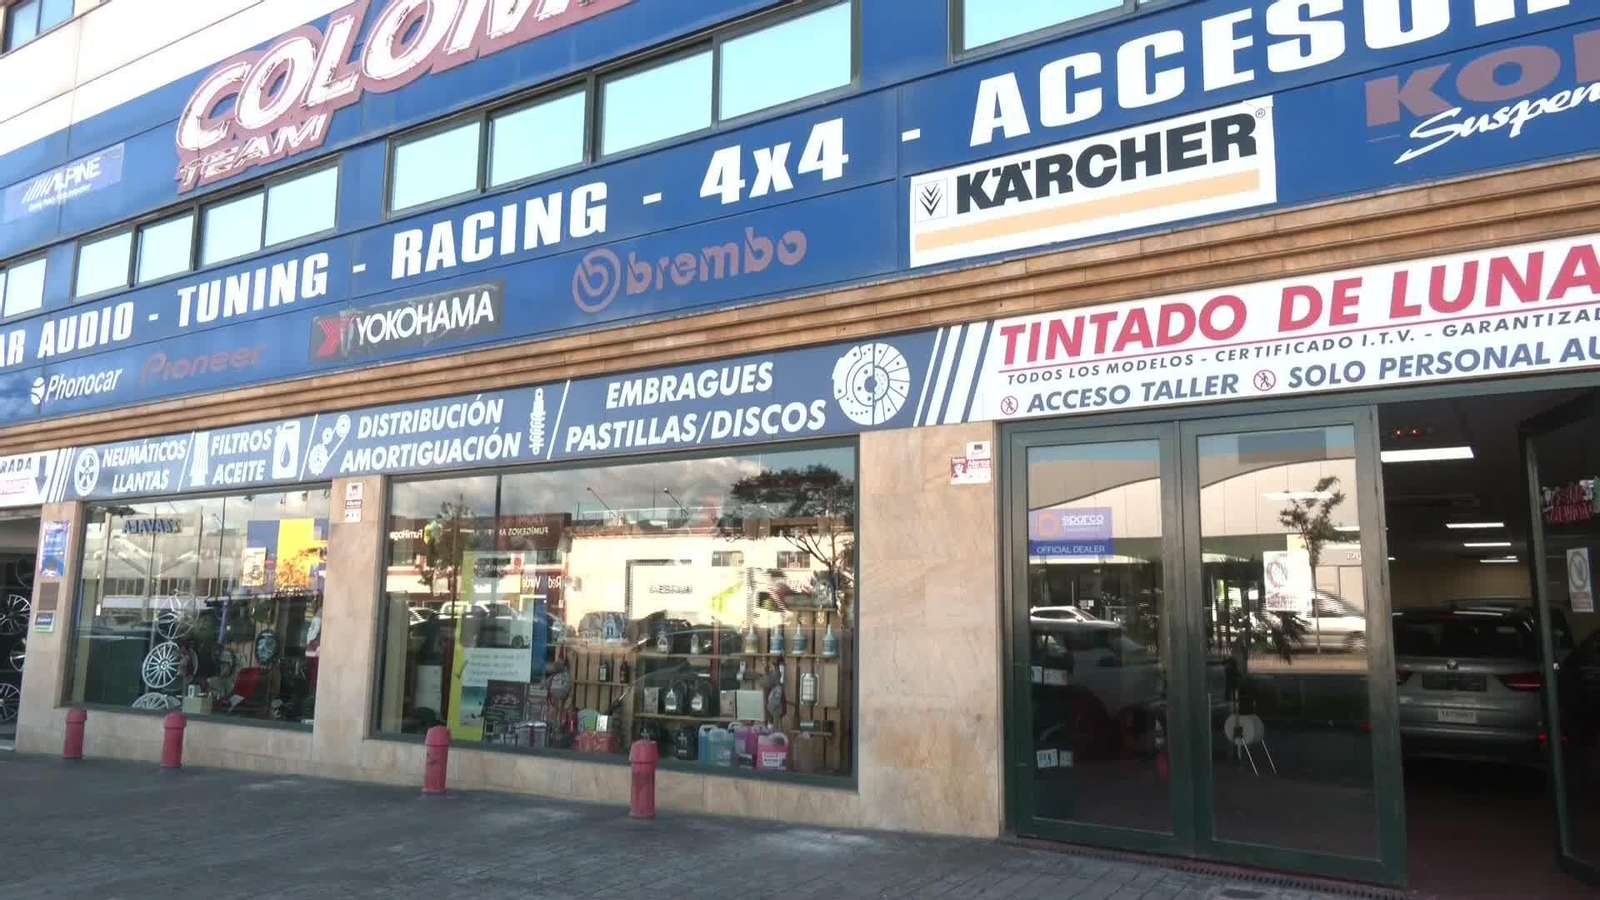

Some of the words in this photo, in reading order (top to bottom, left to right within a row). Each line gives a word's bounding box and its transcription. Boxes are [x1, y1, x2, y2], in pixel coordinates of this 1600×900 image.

[179, 113, 328, 187] TEAM
[957, 112, 1258, 215] KÄRCHER
[40, 156, 102, 196] ALPINE
[0, 329, 26, 368] R
[37, 302, 134, 359] AUDIO
[177, 252, 329, 328] TUNING
[391, 181, 607, 280] RACING
[700, 117, 849, 205] 4x4
[626, 227, 808, 296] brembo
[357, 291, 494, 346] YOKOHAMA
[1000, 294, 1248, 366] TINTADO
[1278, 276, 1363, 332] DE
[1389, 244, 1600, 319] LUNA
[140, 344, 267, 387] Pioneer
[1008, 369, 1063, 386] TODOS
[1069, 364, 1100, 379] LOS
[1106, 353, 1194, 375] MODELOS
[1215, 336, 1353, 363] CERTIFICADO
[1362, 328, 1415, 348] I.T.V.
[1026, 384, 1131, 414] ACCESO
[1140, 373, 1240, 402] TALLER
[1288, 360, 1366, 389] SOLO
[1378, 341, 1551, 381] PERSONAL
[45, 367, 124, 402] Phonocar
[605, 361, 774, 410] EMBRAGUES
[357, 394, 504, 440] DISTRIBUCIÓN
[565, 399, 827, 453] PASTILLAS/DISCOS
[102, 438, 188, 468] NEUMÁTICOS
[211, 428, 274, 457] FILTROS
[339, 426, 522, 474] AMORTIGUACIÓN
[112, 469, 171, 495] LLANTAS
[212, 460, 266, 485] ACEITE
[1062, 514, 1104, 526] sparco
[1036, 545, 1072, 554] OFFICIAL
[1073, 545, 1105, 553] DEALER
